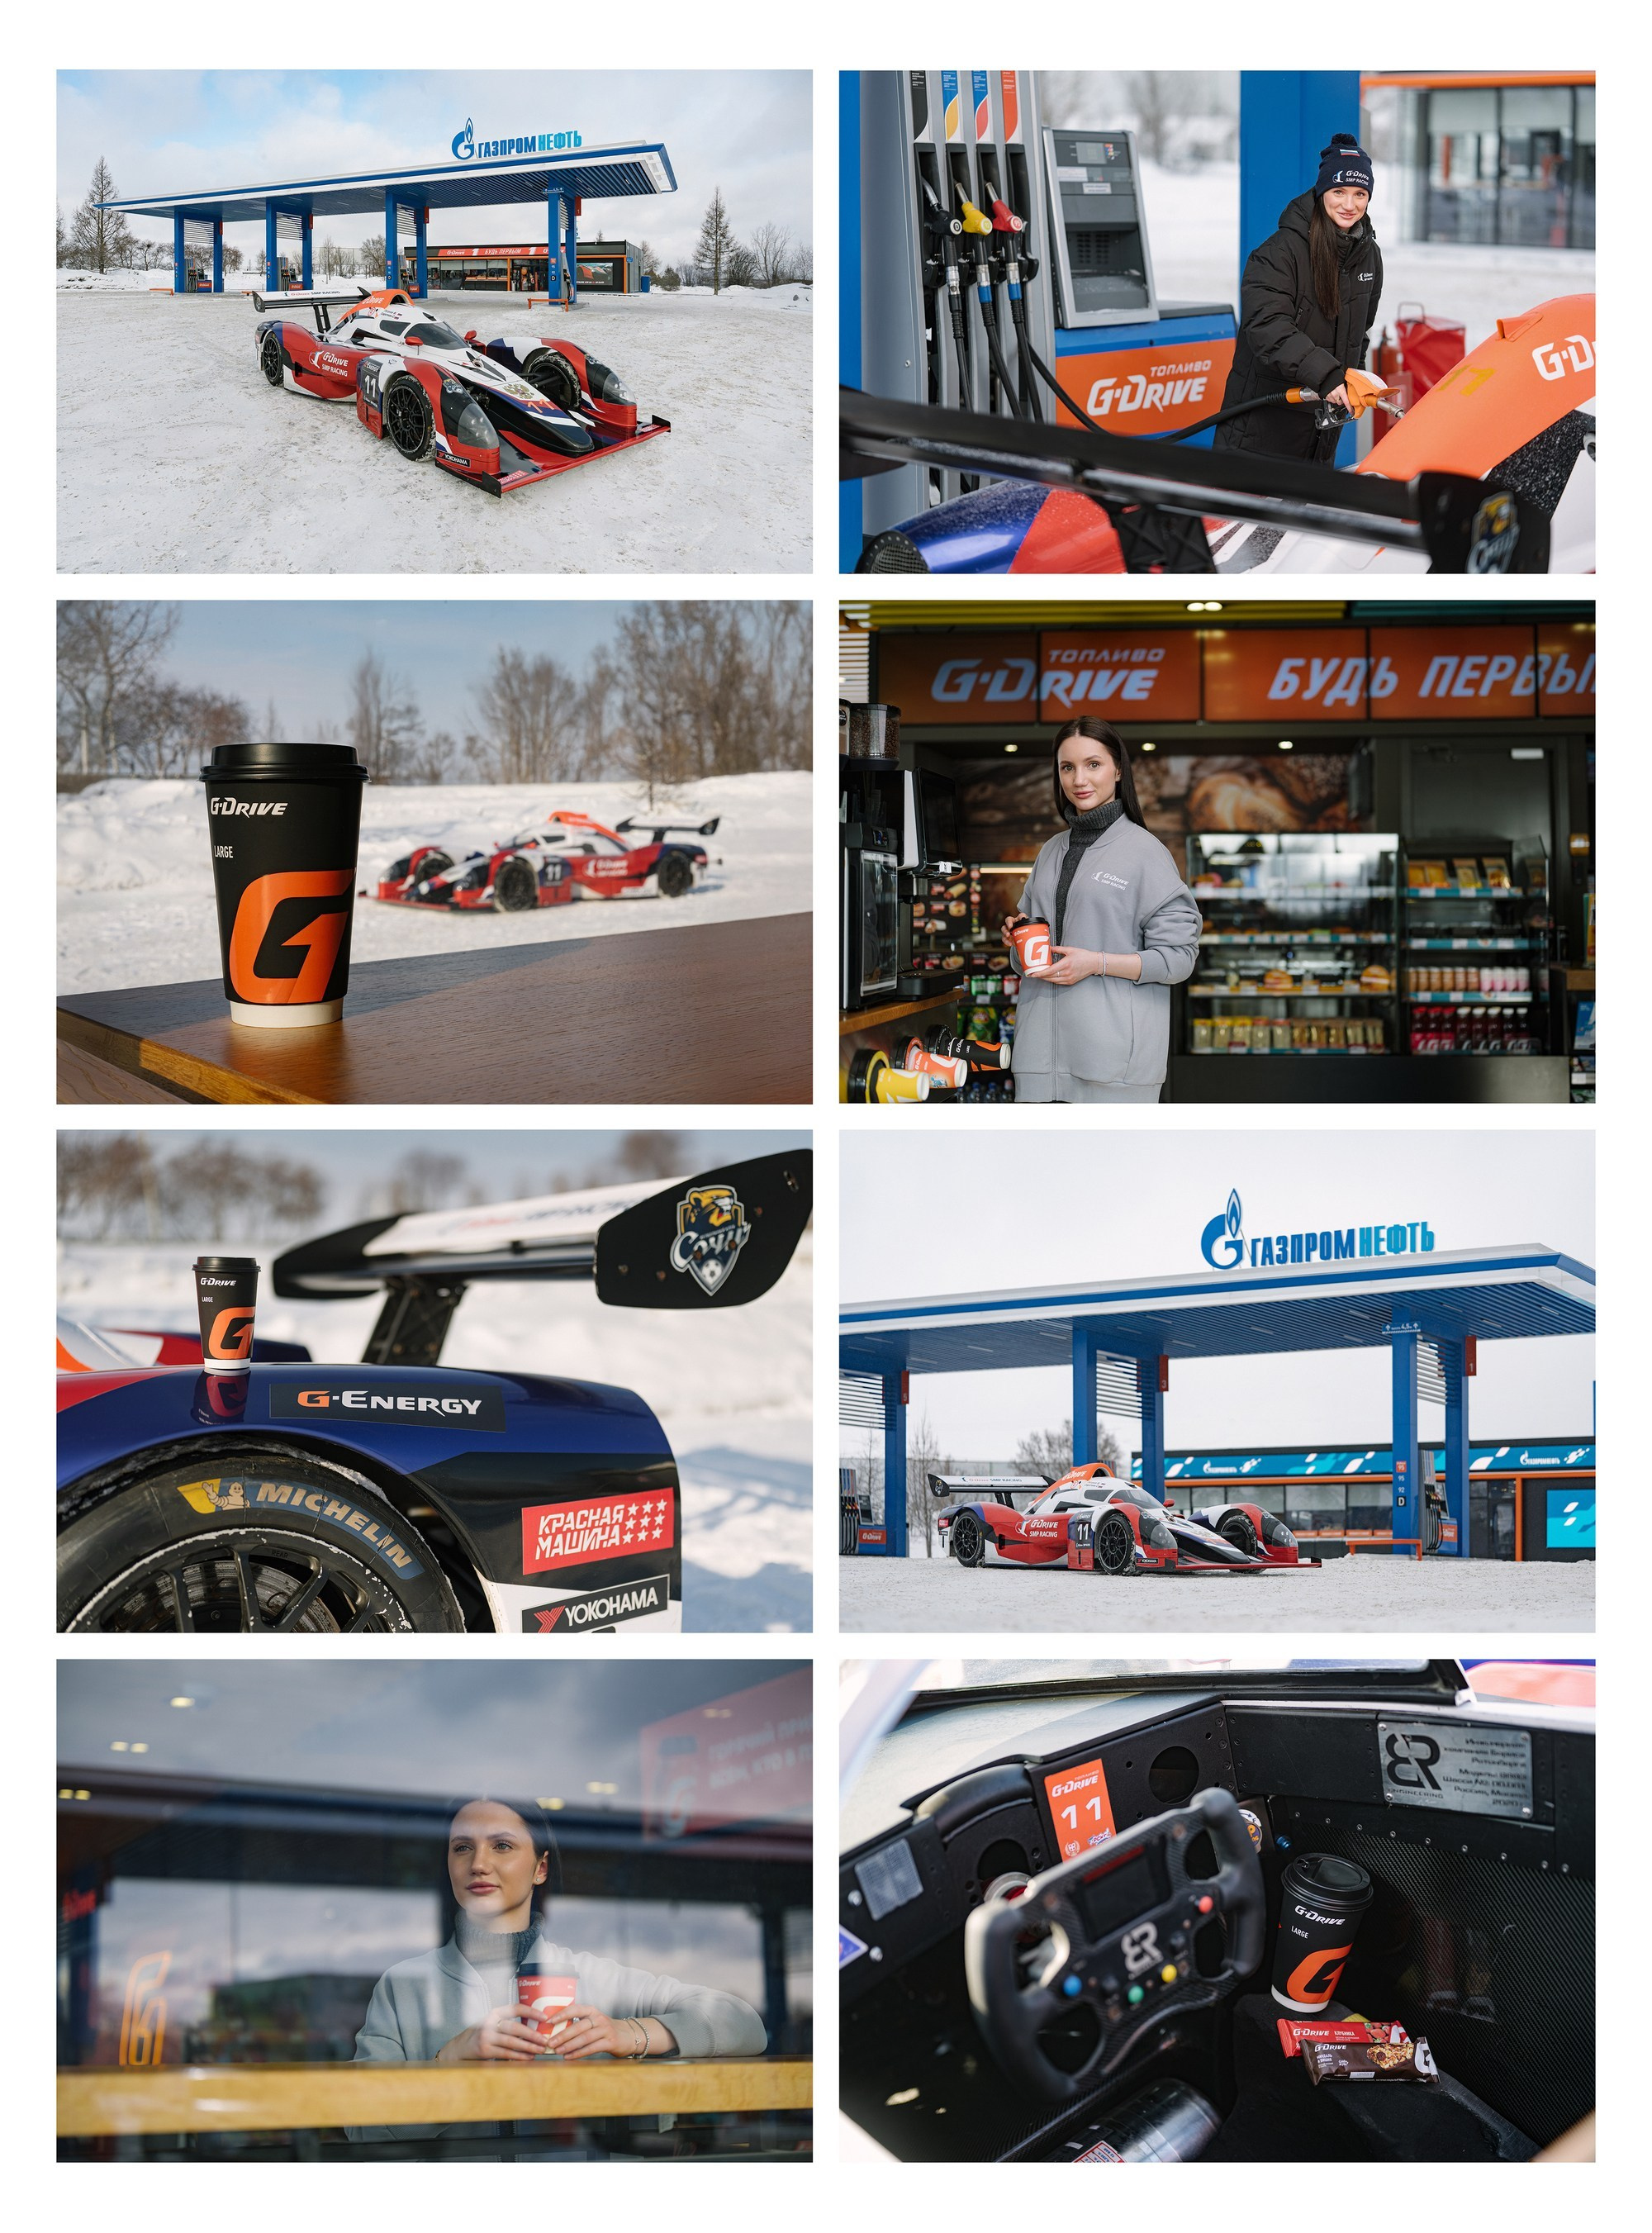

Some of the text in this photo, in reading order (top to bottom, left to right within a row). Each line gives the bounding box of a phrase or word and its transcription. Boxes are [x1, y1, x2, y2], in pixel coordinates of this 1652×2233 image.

[478, 131, 582, 158] ГАЗПРОМНЕФТЬ
[1150, 360, 1212, 378] ТОПЛИВО
[1531, 335, 1596, 381] G-D
[322, 363, 348, 377] SMP RACING
[365, 375, 377, 398] 11
[1086, 374, 1208, 416] G-DRIVE
[444, 454, 469, 466] YOKOHAMA
[1048, 649, 1165, 663] ТОПЛИВО
[931, 658, 1159, 709] G-DRIVE
[1267, 653, 1596, 707] БУДЬ ПЕРВЫ
[210, 796, 288, 819] G-DRIVE
[214, 845, 234, 859] LARGE
[1251, 1221, 1435, 1267] ГАЗПРОМНЕФТЬ
[200, 1277, 237, 1287] G-DRIVE
[297, 1390, 482, 1418] G-ENERGY
[1398, 1497, 1404, 1506] D
[256, 1483, 412, 1568] MICHELIN
[539, 1505, 624, 1535] КРАСНАЯ
[535, 1525, 620, 1560] МАШИНА
[1077, 1523, 1089, 1541] 11
[271, 1550, 288, 1559] REAR
[565, 1587, 659, 1627] YOKOHAMA
[1051, 1775, 1099, 1798] G-DRIVE
[1294, 1905, 1346, 1926] G-DRIVE
[1291, 1925, 1308, 1939] LARGE
[1293, 2028, 1330, 2037] G-DRIVE
[1315, 2044, 1346, 2052] G-DRIVE
